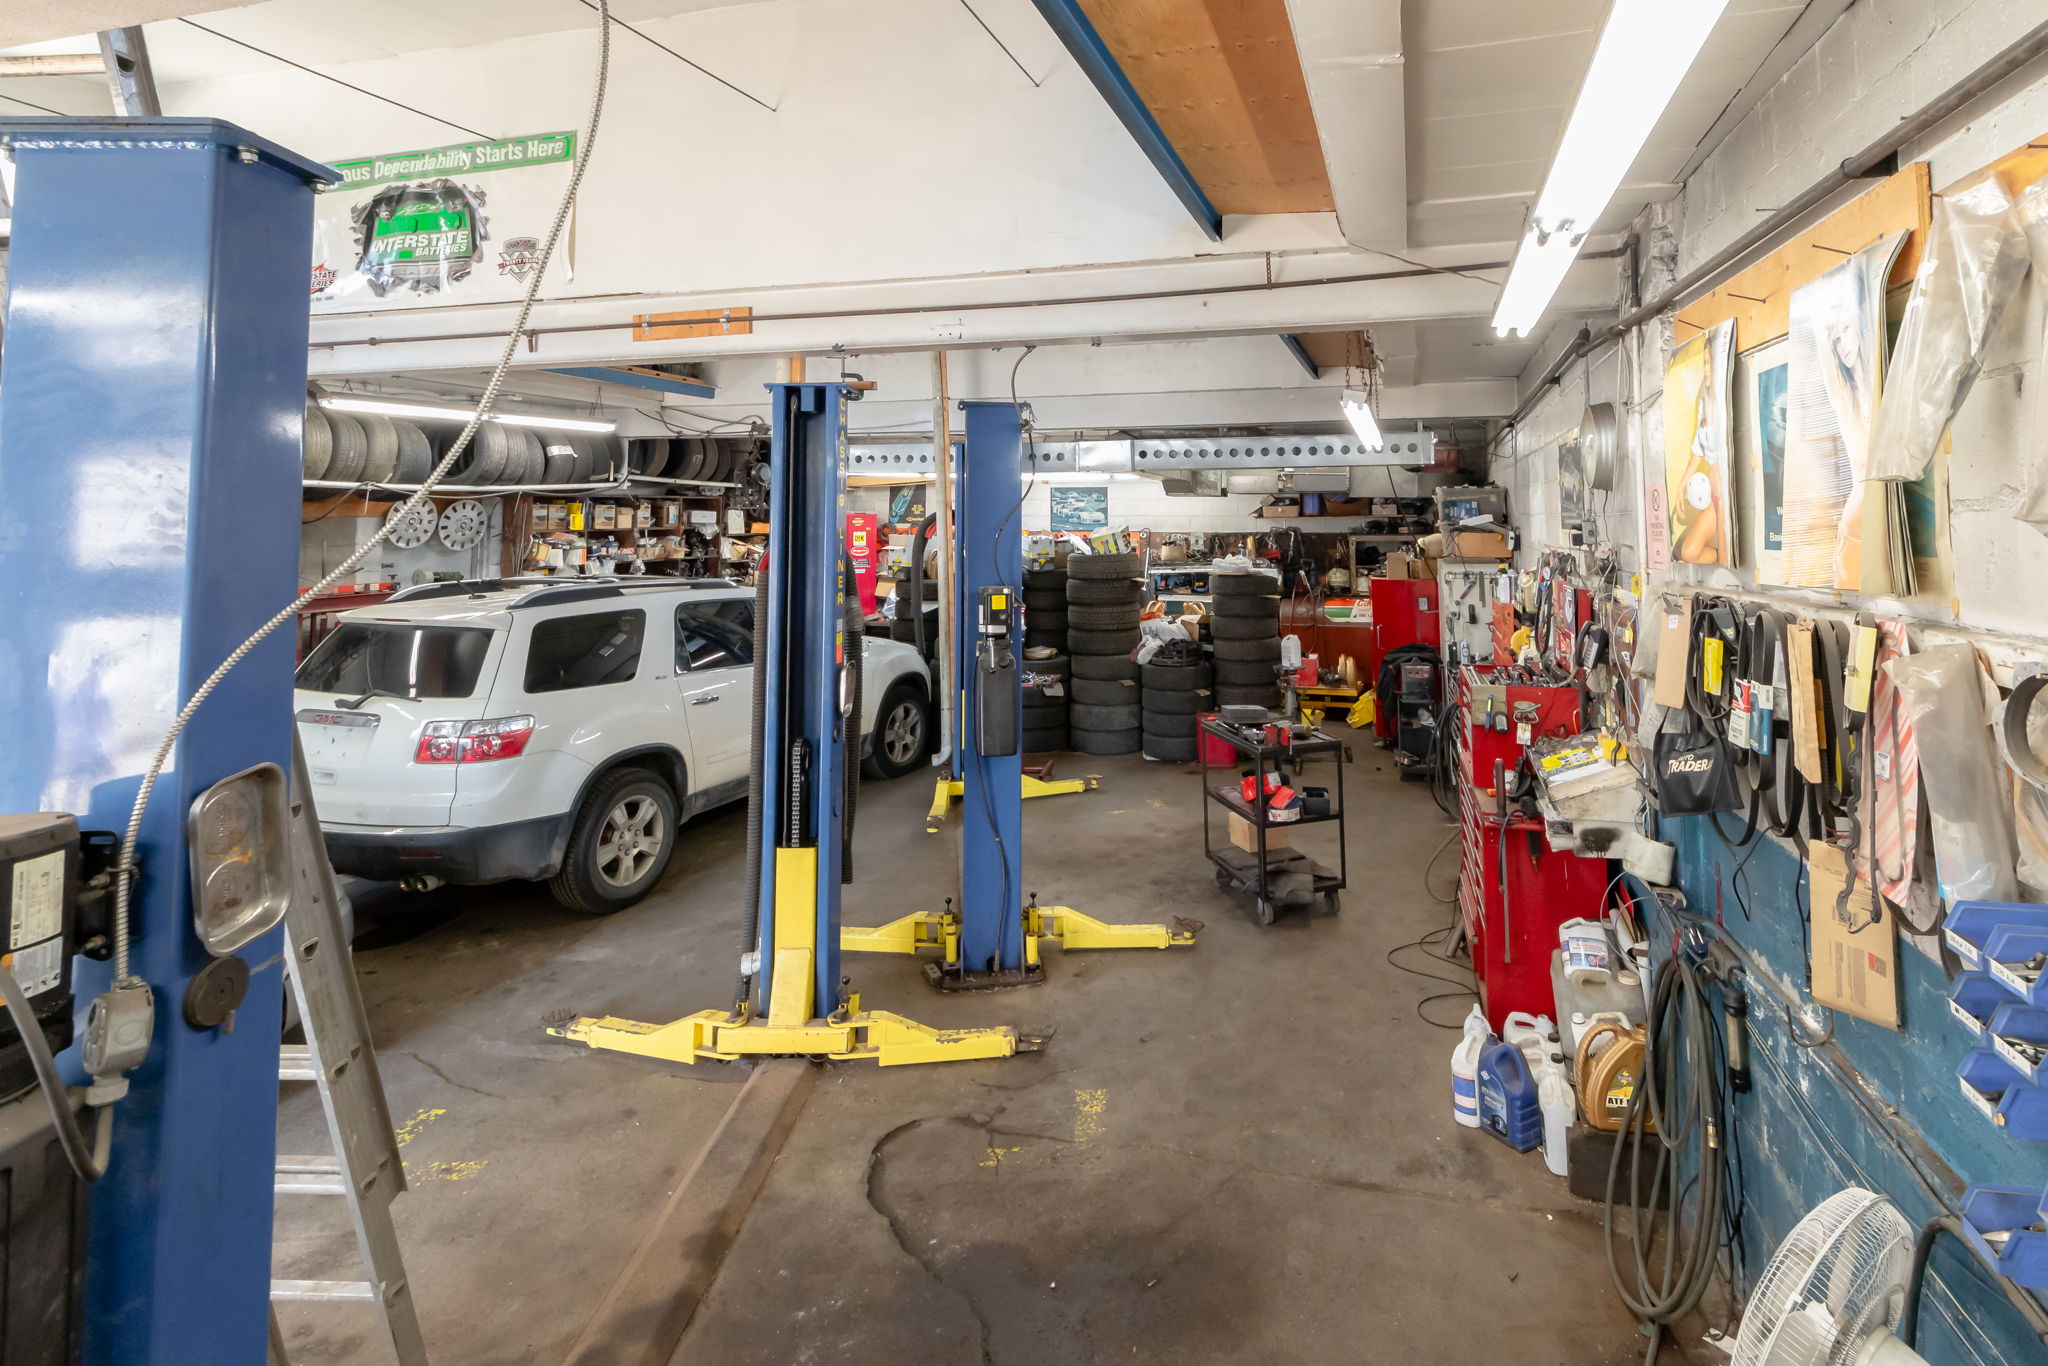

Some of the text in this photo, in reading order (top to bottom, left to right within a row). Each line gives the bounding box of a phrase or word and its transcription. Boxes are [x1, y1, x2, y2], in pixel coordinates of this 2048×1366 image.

[342, 140, 564, 182] ous Dependability Starts Here
[370, 231, 469, 253] INTERSTATE
[415, 243, 467, 256] BATTERIES
[312, 271, 337, 280] STATE
[311, 280, 334, 288] ERIES
[837, 527, 845, 605] LINER
[314, 714, 344, 725] GMC
